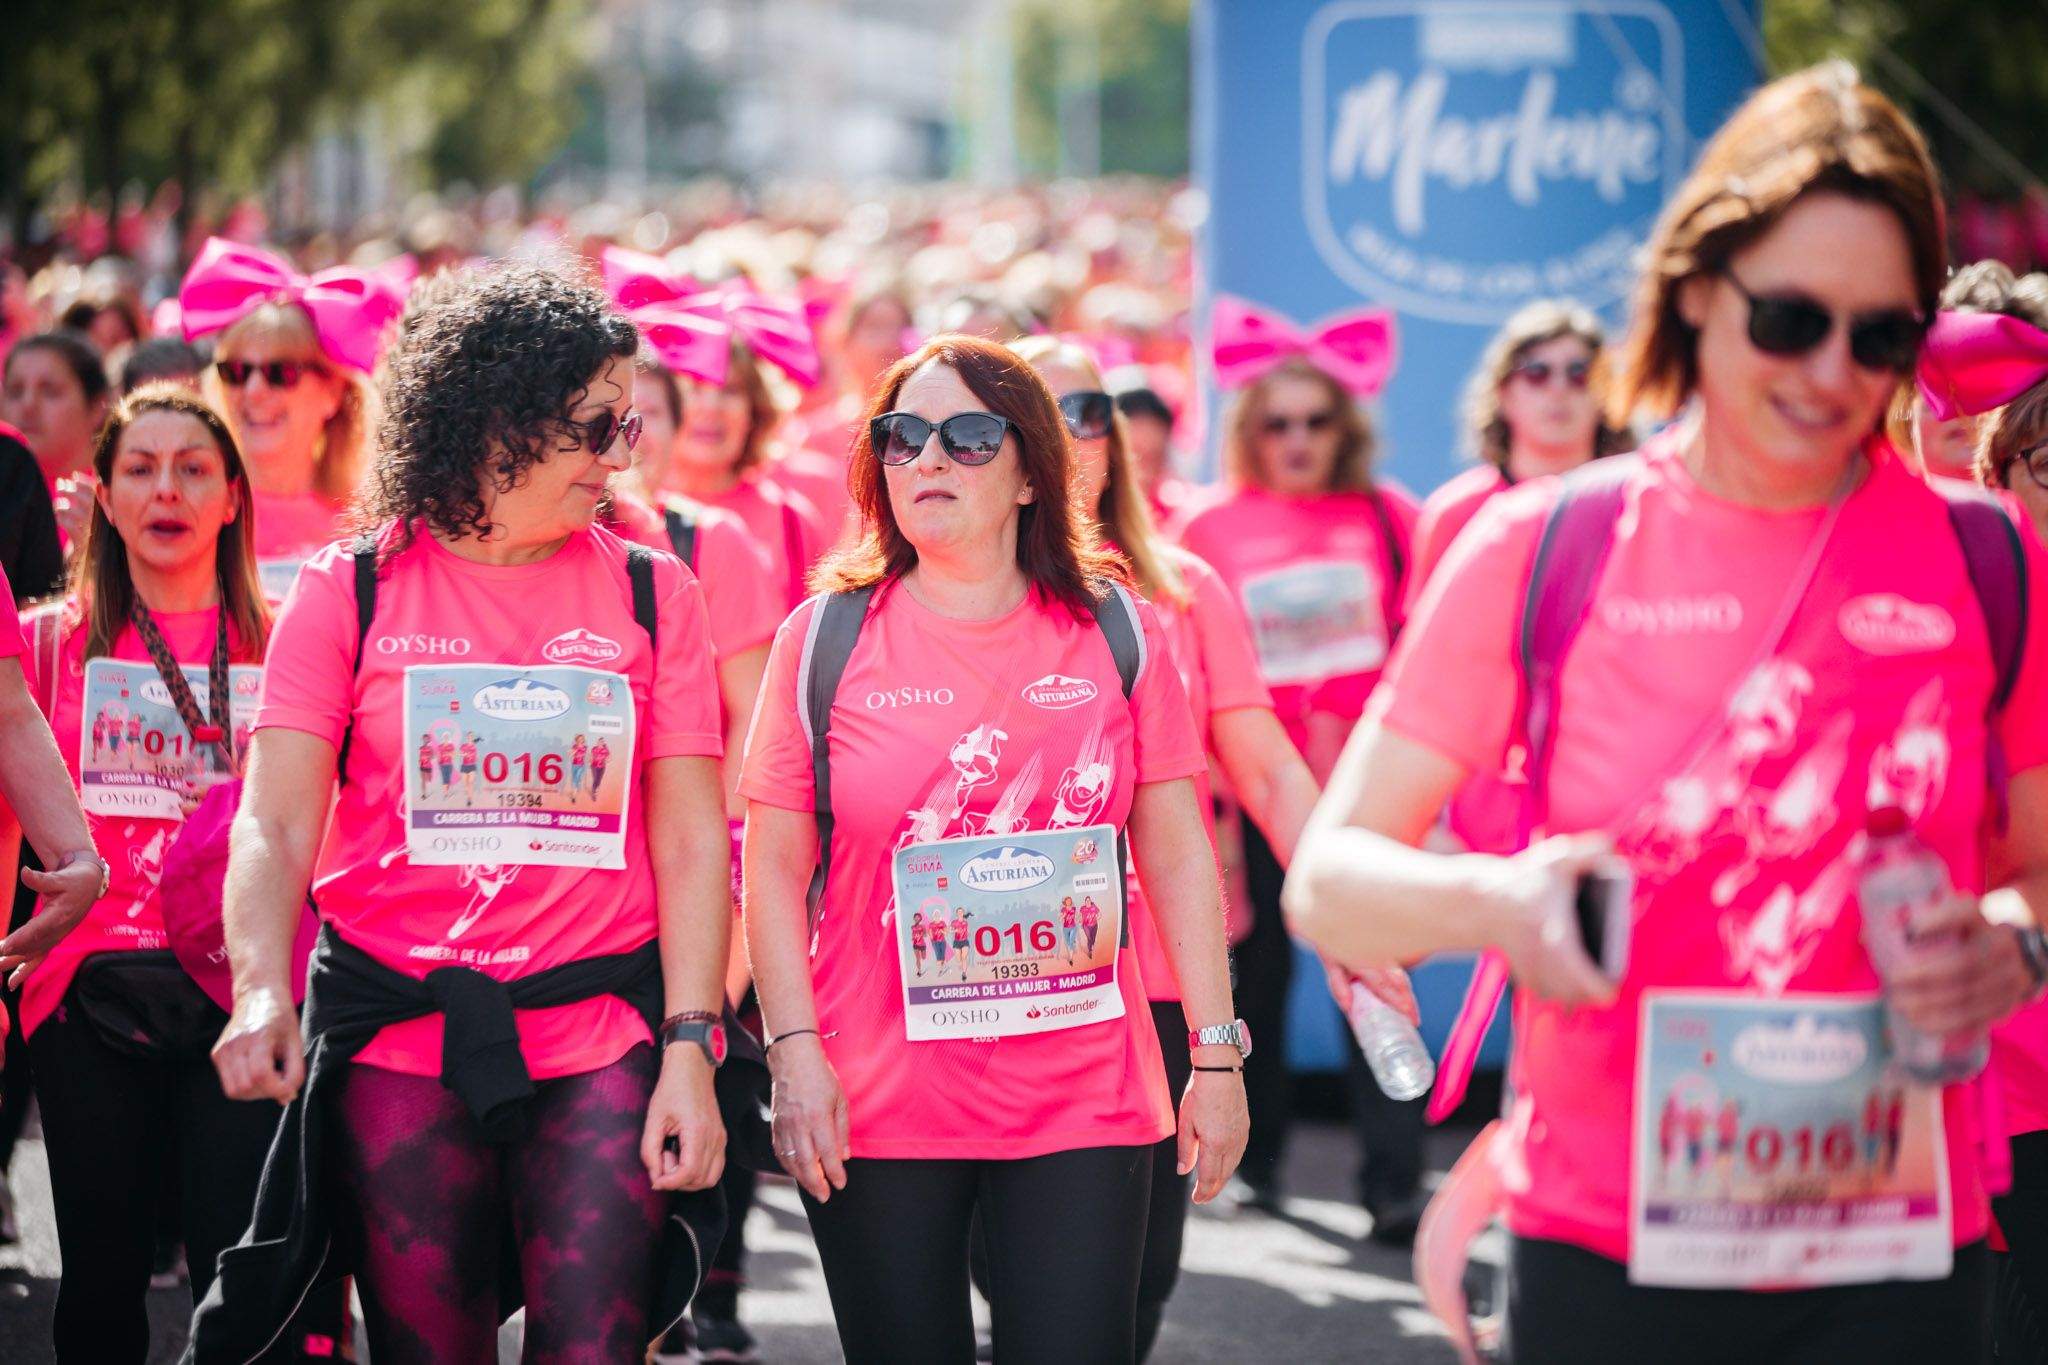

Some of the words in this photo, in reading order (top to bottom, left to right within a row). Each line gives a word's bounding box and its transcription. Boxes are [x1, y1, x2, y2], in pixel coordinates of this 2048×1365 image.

[1328, 67, 1663, 235] Marlene
[376, 633, 471, 656] OYSHO
[552, 644, 615, 658] ASTURIANA
[480, 693, 563, 711] ASTURIANA
[866, 686, 954, 710] OYSHO
[1029, 687, 1093, 704] ASTURIANA
[482, 752, 563, 785] 016
[99, 791, 157, 807] OYSHO
[433, 813, 484, 825] CARRERA
[486, 812, 500, 824] DE
[502, 812, 517, 823] LA
[432, 835, 502, 852] OYSHO
[1075, 840, 1095, 856] 20
[907, 862, 944, 874] SUMA
[967, 866, 1049, 883] ASTURIANA
[975, 921, 1056, 957] 016
[460, 948, 476, 963] DE
[991, 962, 1039, 980] 19393
[931, 986, 980, 1000] CARRERA
[982, 985, 996, 997] DE
[999, 984, 1013, 995] LA
[1015, 980, 1050, 993] MUJER
[1059, 973, 1096, 989] MADRID
[932, 1008, 1000, 1026] OYSHO
[1043, 999, 1099, 1018] Santander
[1744, 1124, 1856, 1174] 016
